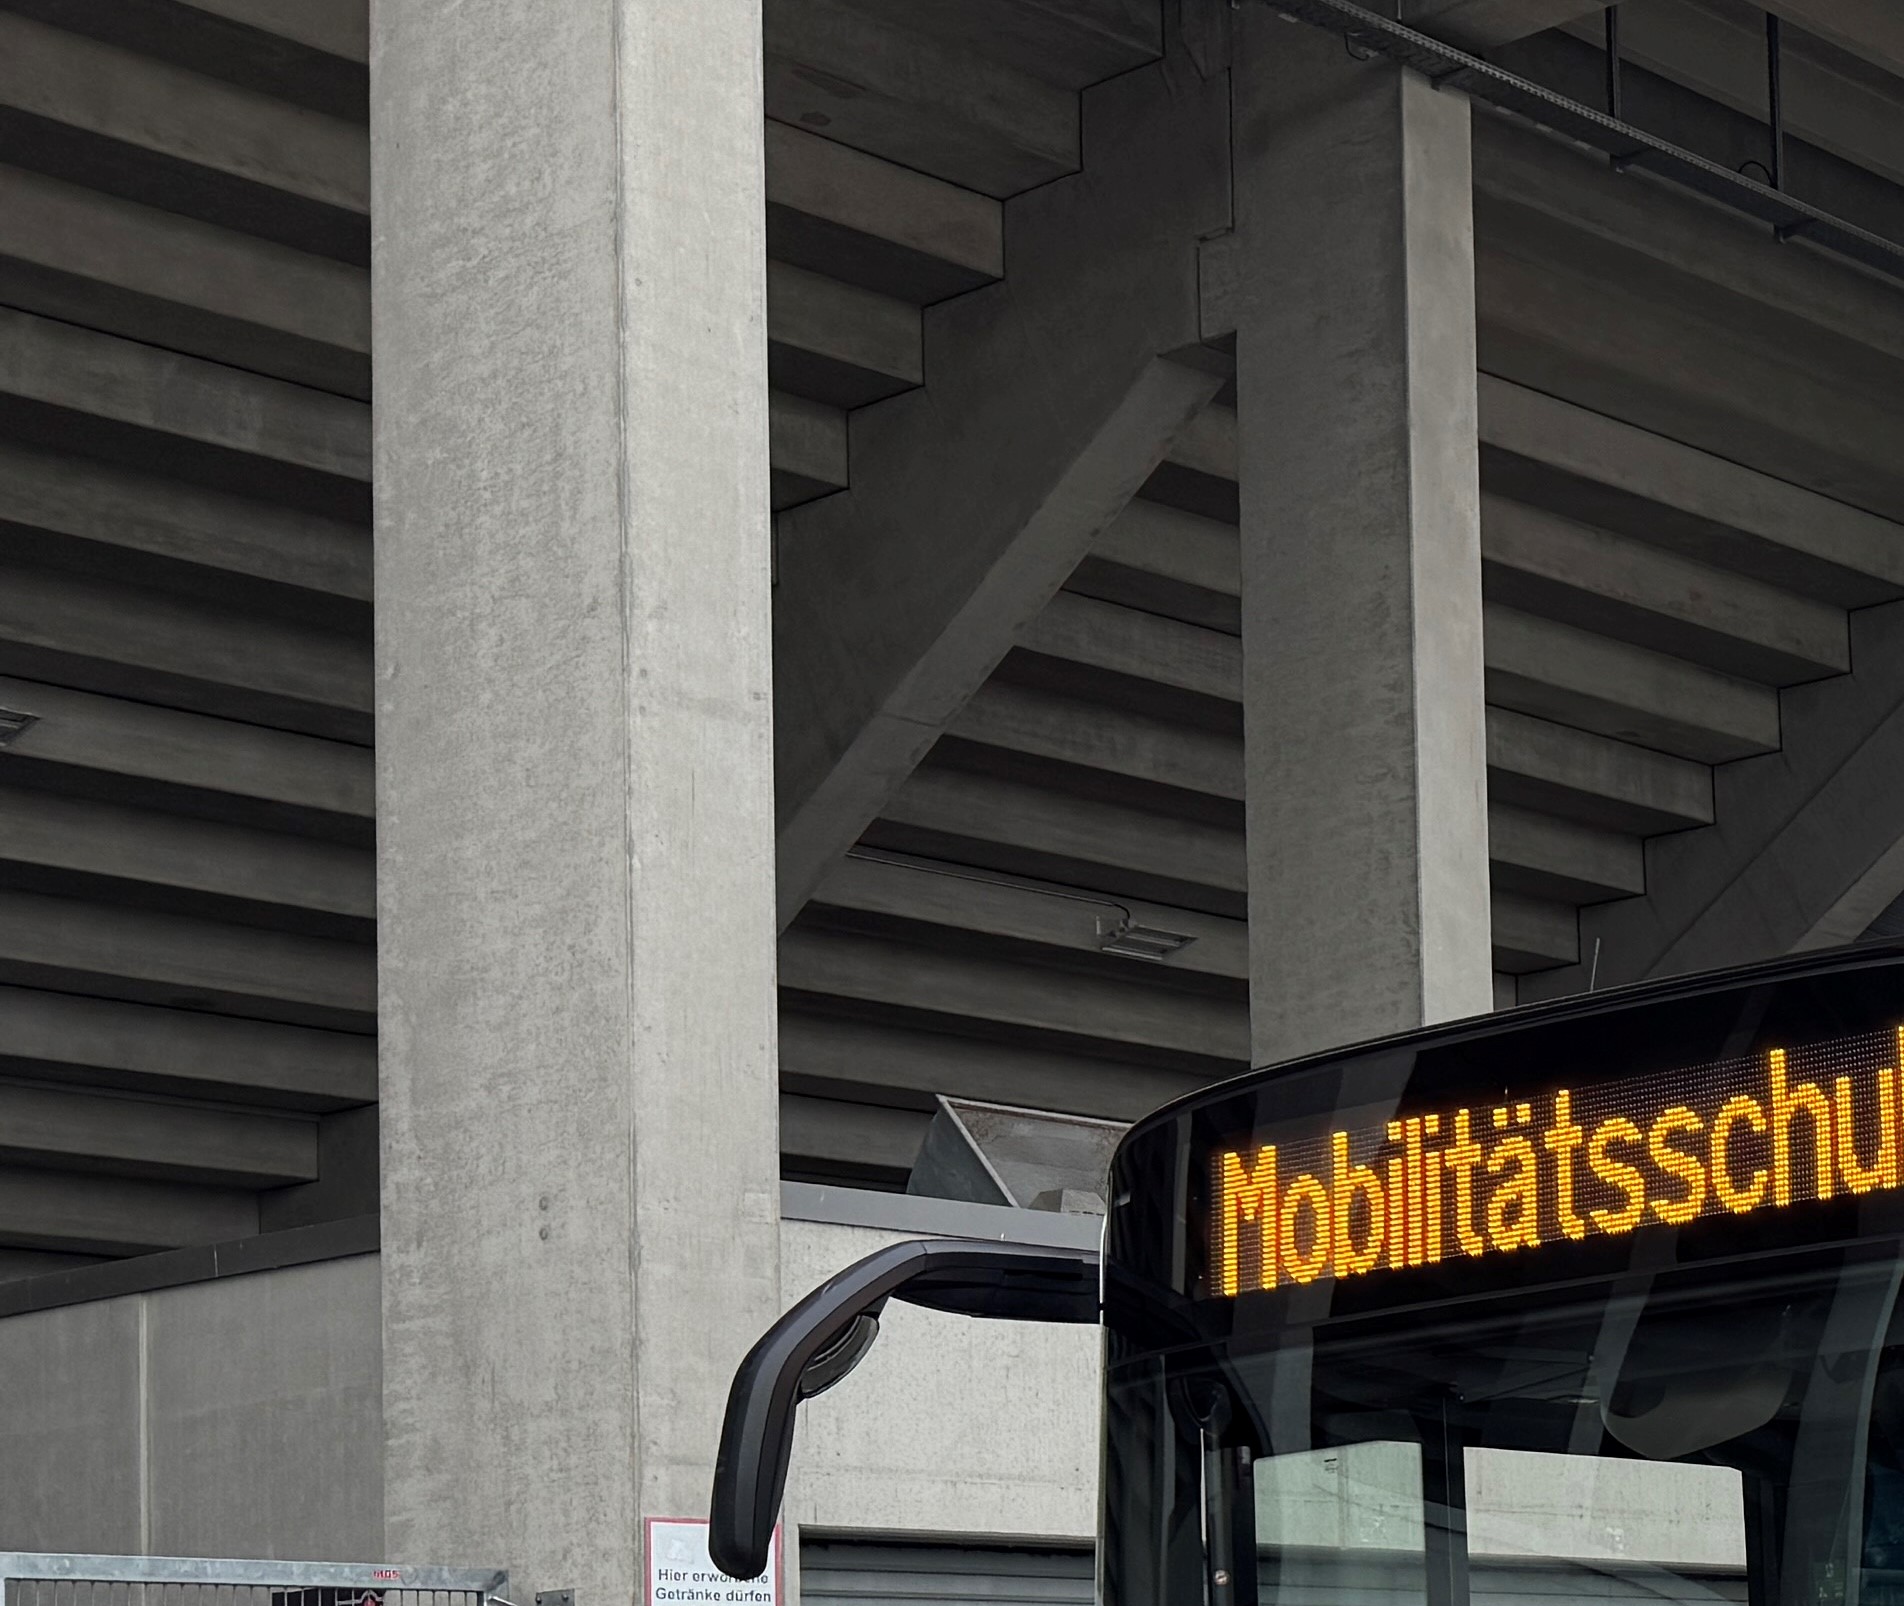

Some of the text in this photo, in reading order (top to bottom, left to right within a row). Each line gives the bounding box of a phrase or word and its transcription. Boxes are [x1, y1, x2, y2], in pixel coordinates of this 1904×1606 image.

[658, 1568, 688, 1582] Hier
[655, 1587, 772, 1603] Getränke dürfen
